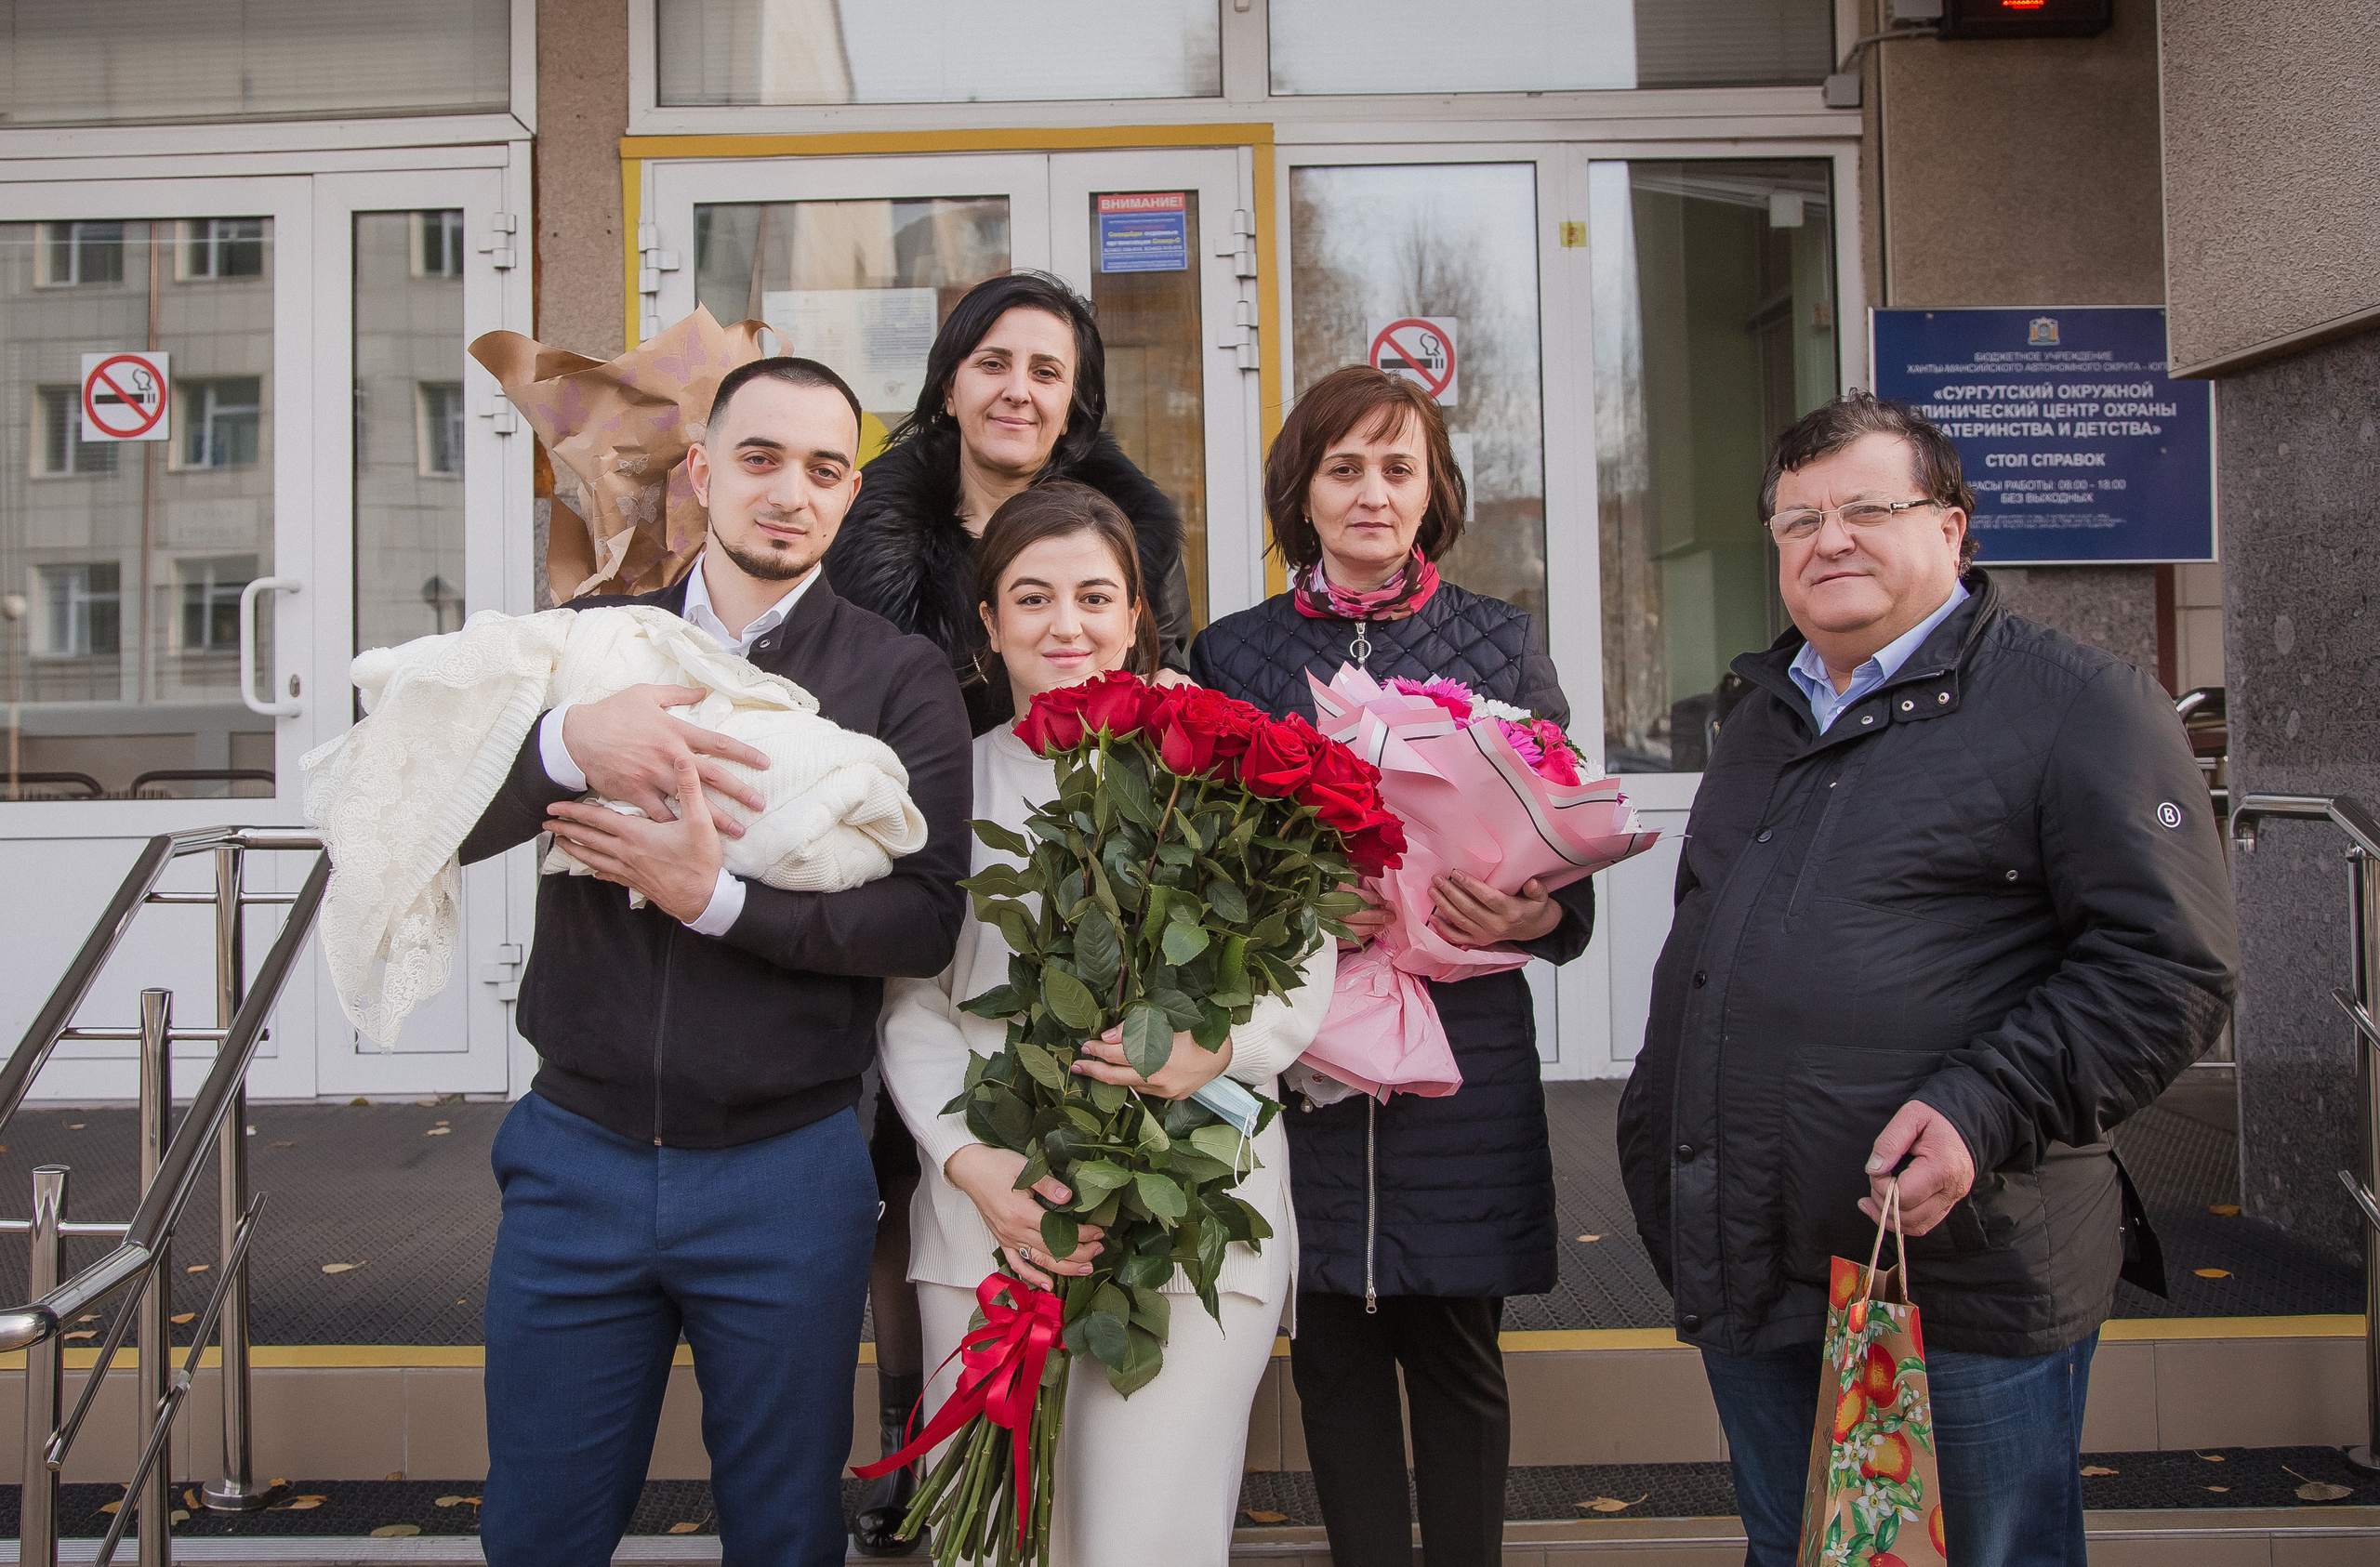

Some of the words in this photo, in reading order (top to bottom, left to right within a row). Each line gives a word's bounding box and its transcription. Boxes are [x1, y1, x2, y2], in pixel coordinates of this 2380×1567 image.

[1101, 196, 1183, 210] ВНИМАНИЕ!
[1974, 351, 2043, 362] БЮДЖЕТНОЕ
[2043, 350, 2113, 362] УЧРЕЖДЕНИЕ
[2024, 362, 2101, 372] АВТОНОМНОГО
[2102, 362, 2142, 372] ОКРУГА
[1934, 381, 2054, 400] «СУРГУТСКИЙ
[2057, 380, 2154, 399] ОКРУЖНОЙ
[2043, 402, 2100, 420] ЦЕНТР
[2103, 402, 2176, 417] ОХРАНЫ
[1934, 422, 2055, 438] АТЕРИНСТВА
[2057, 421, 2071, 436] И
[2073, 421, 2162, 439] ДЕТСТВА»
[1985, 453, 2028, 467] СТОЛ
[2031, 453, 2106, 467] СПРАВОК
[2001, 493, 2024, 504] БЕЗ
[2025, 492, 2094, 505] ВЫХОДНЫХ
